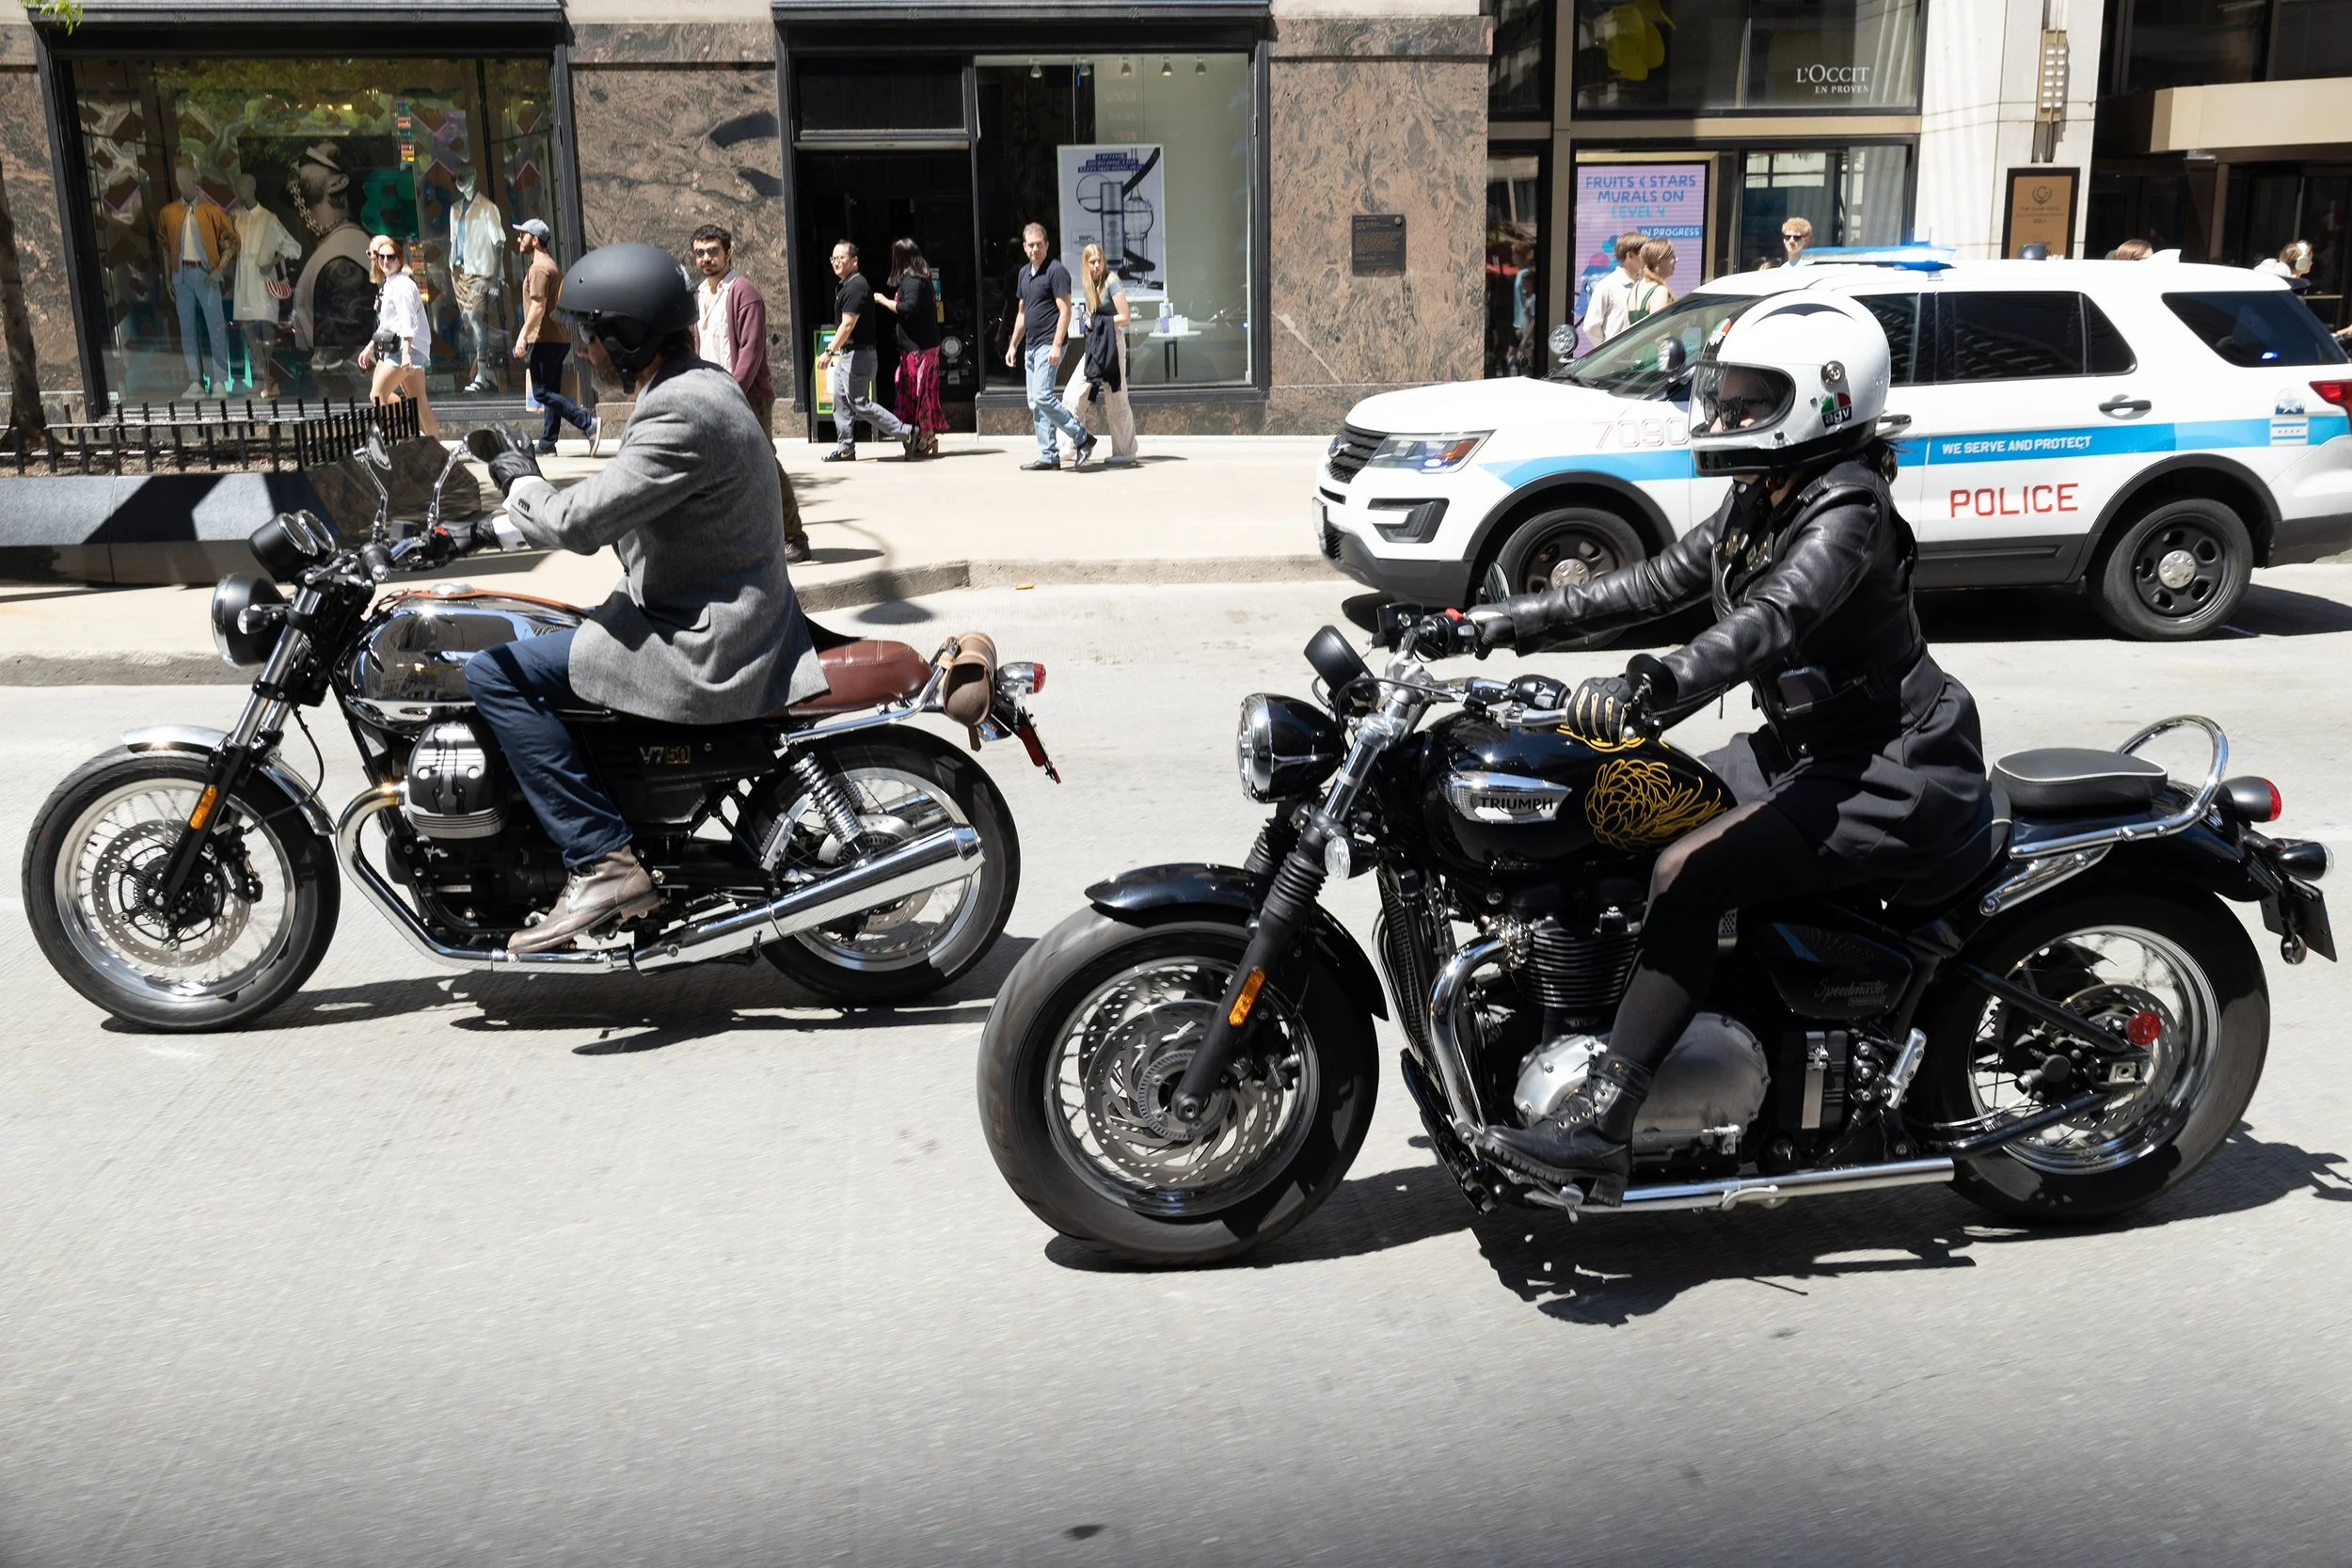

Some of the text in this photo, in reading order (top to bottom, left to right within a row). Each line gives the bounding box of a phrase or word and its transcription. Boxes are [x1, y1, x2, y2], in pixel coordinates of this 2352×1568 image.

[1815, 86, 1827, 94] EN
[1585, 176, 1635, 188] FRUITS
[1649, 175, 1696, 187] STARS
[1597, 190, 1685, 202] MURALS ON
[1611, 205, 1665, 218] LEVEL 4
[1641, 227, 1700, 237] IN PROGRESS
[1824, 407, 1851, 423] agv
[1590, 417, 1690, 450] 7090
[1942, 436, 2092, 455] WE SERVE AND PROTECT
[1950, 483, 2078, 518] POLICE
[640, 746, 664, 764] V7
[1479, 797, 1553, 810] TRIUMPH
[1814, 977, 1888, 1004] Speedmaster
